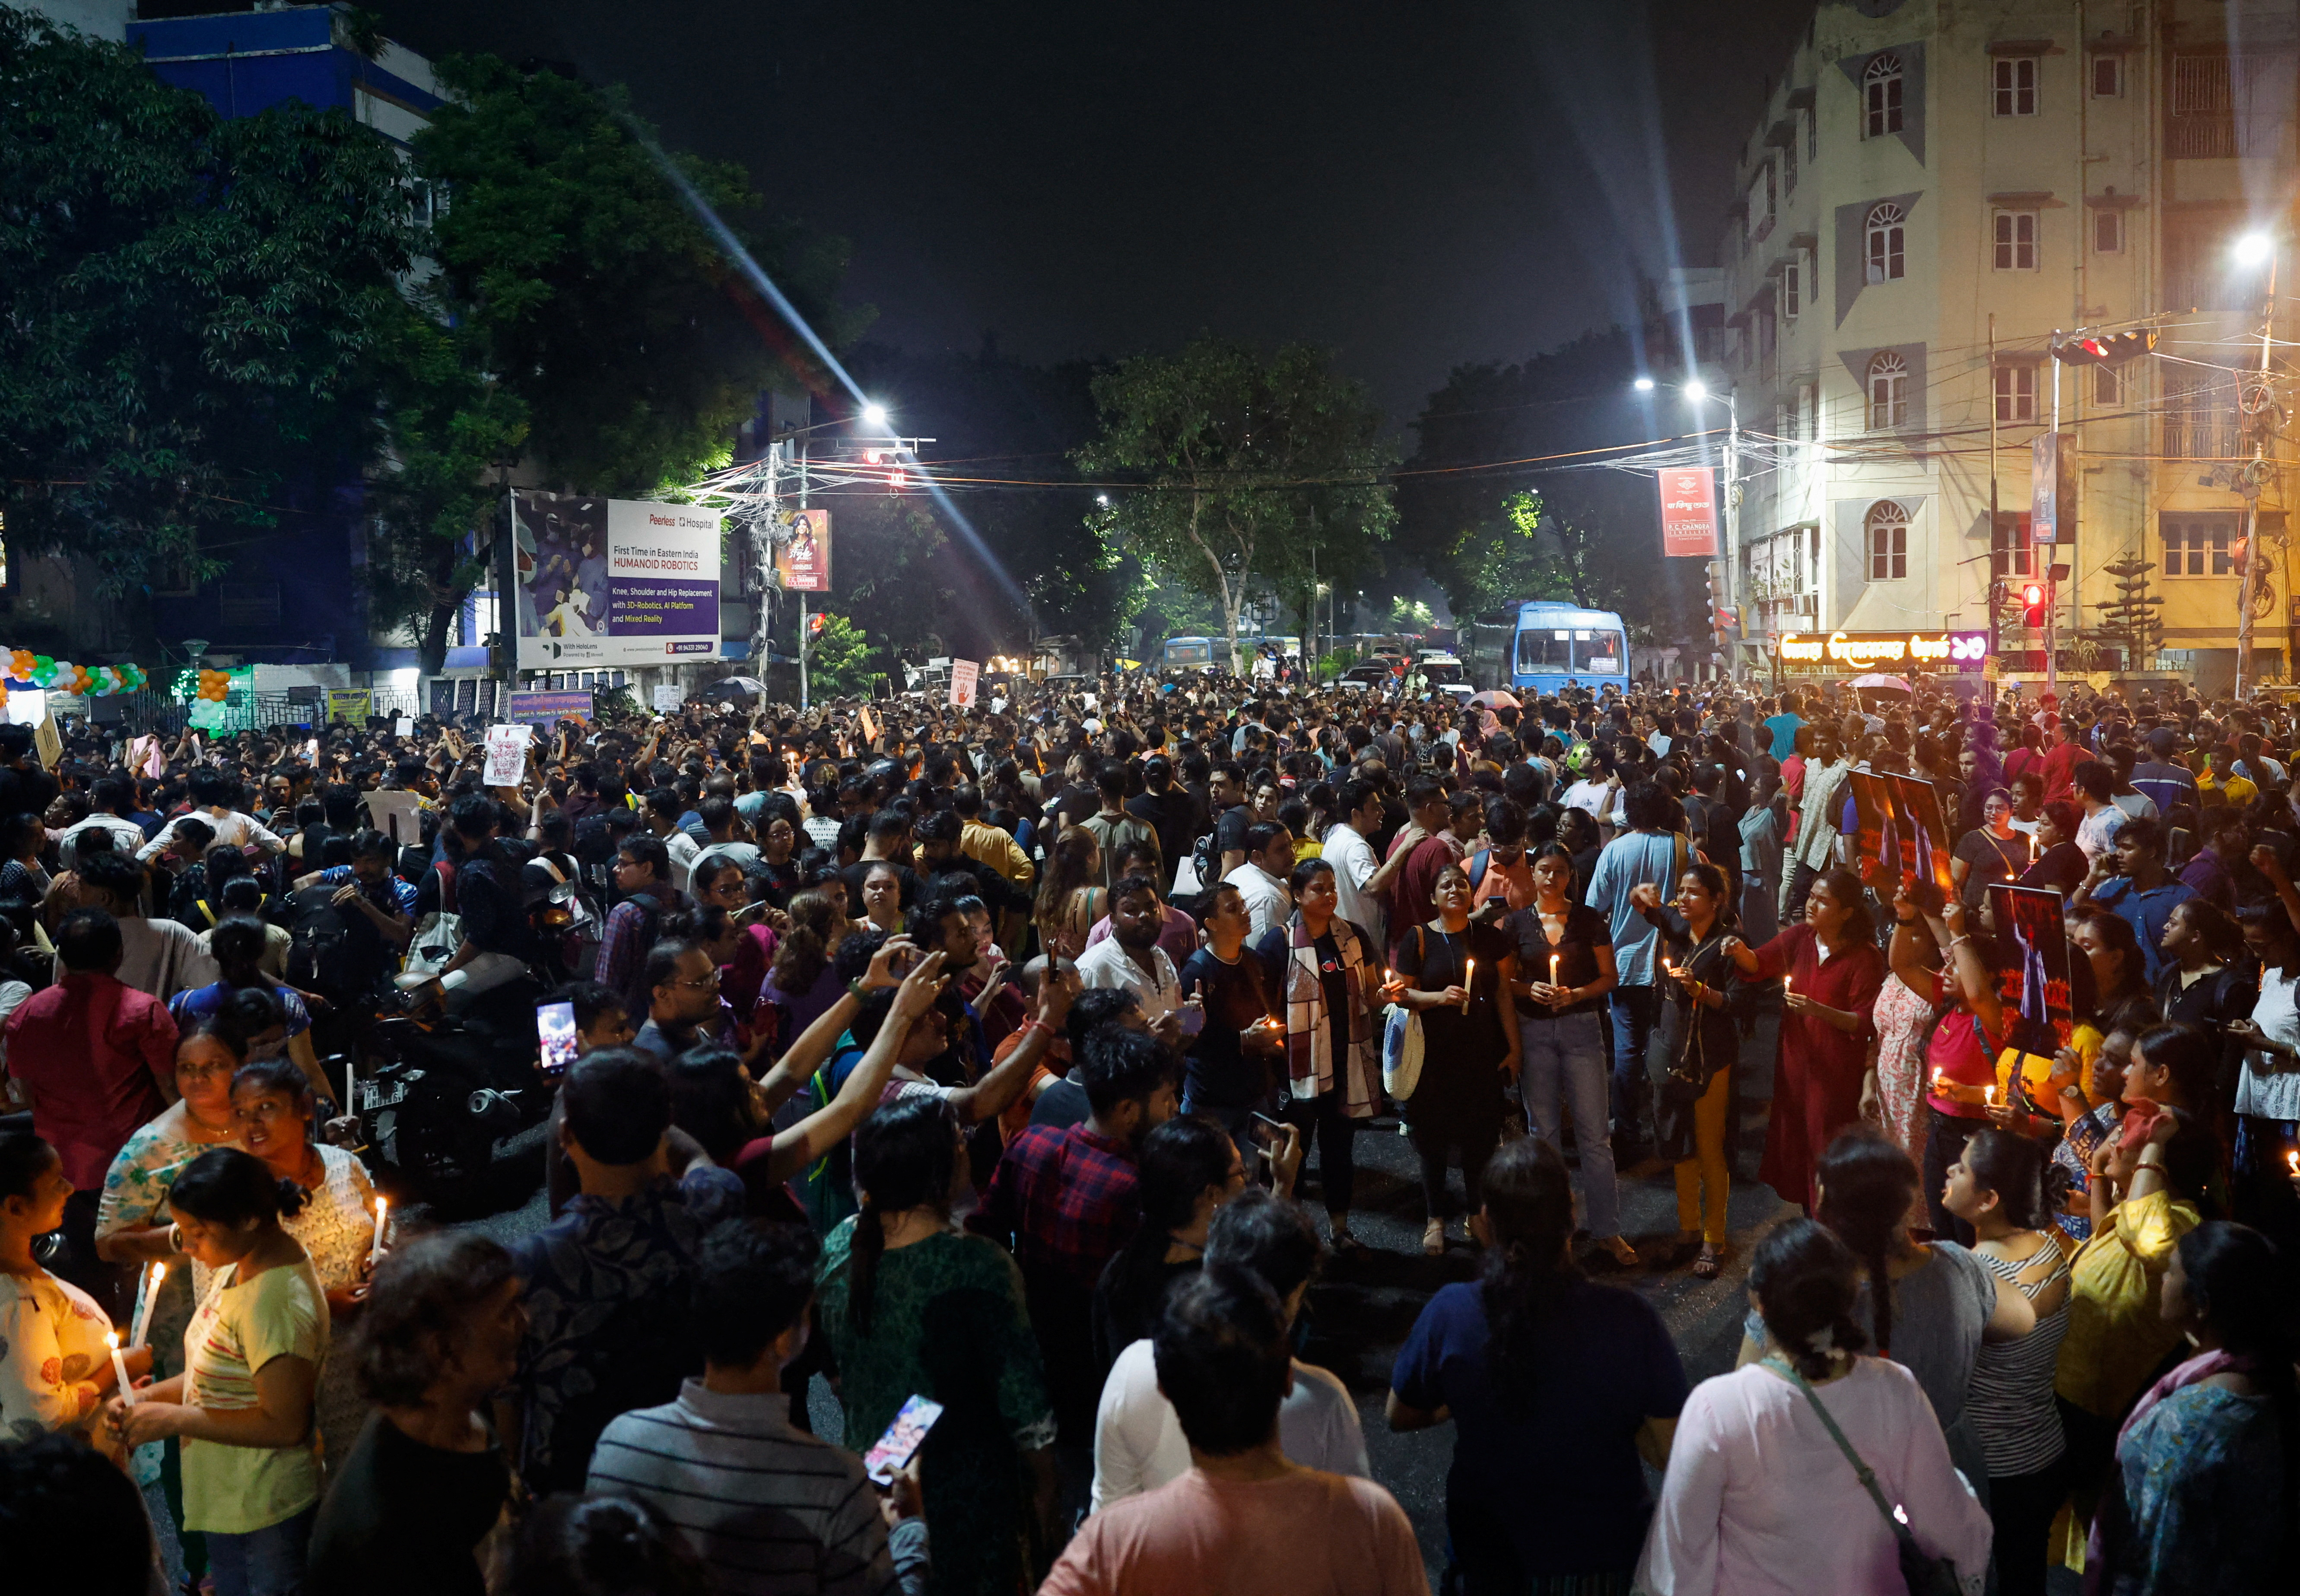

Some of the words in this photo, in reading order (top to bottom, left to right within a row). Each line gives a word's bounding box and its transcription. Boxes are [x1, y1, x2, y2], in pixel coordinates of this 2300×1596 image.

[649, 514, 675, 526] Peerless
[686, 518, 713, 530] Hospital
[614, 545, 629, 555] First
[631, 546, 648, 556] Time
[650, 548, 656, 556] in
[658, 549, 681, 558] Eastern
[683, 550, 698, 559] India
[614, 557, 659, 569] HUMANOID
[661, 560, 698, 570] ROBOTICS
[613, 588, 629, 596] Knee,
[668, 589, 677, 598] Hip
[679, 589, 712, 598] Replacement
[627, 601, 663, 610] 3D-Robotics,
[644, 615, 662, 624] Reality
